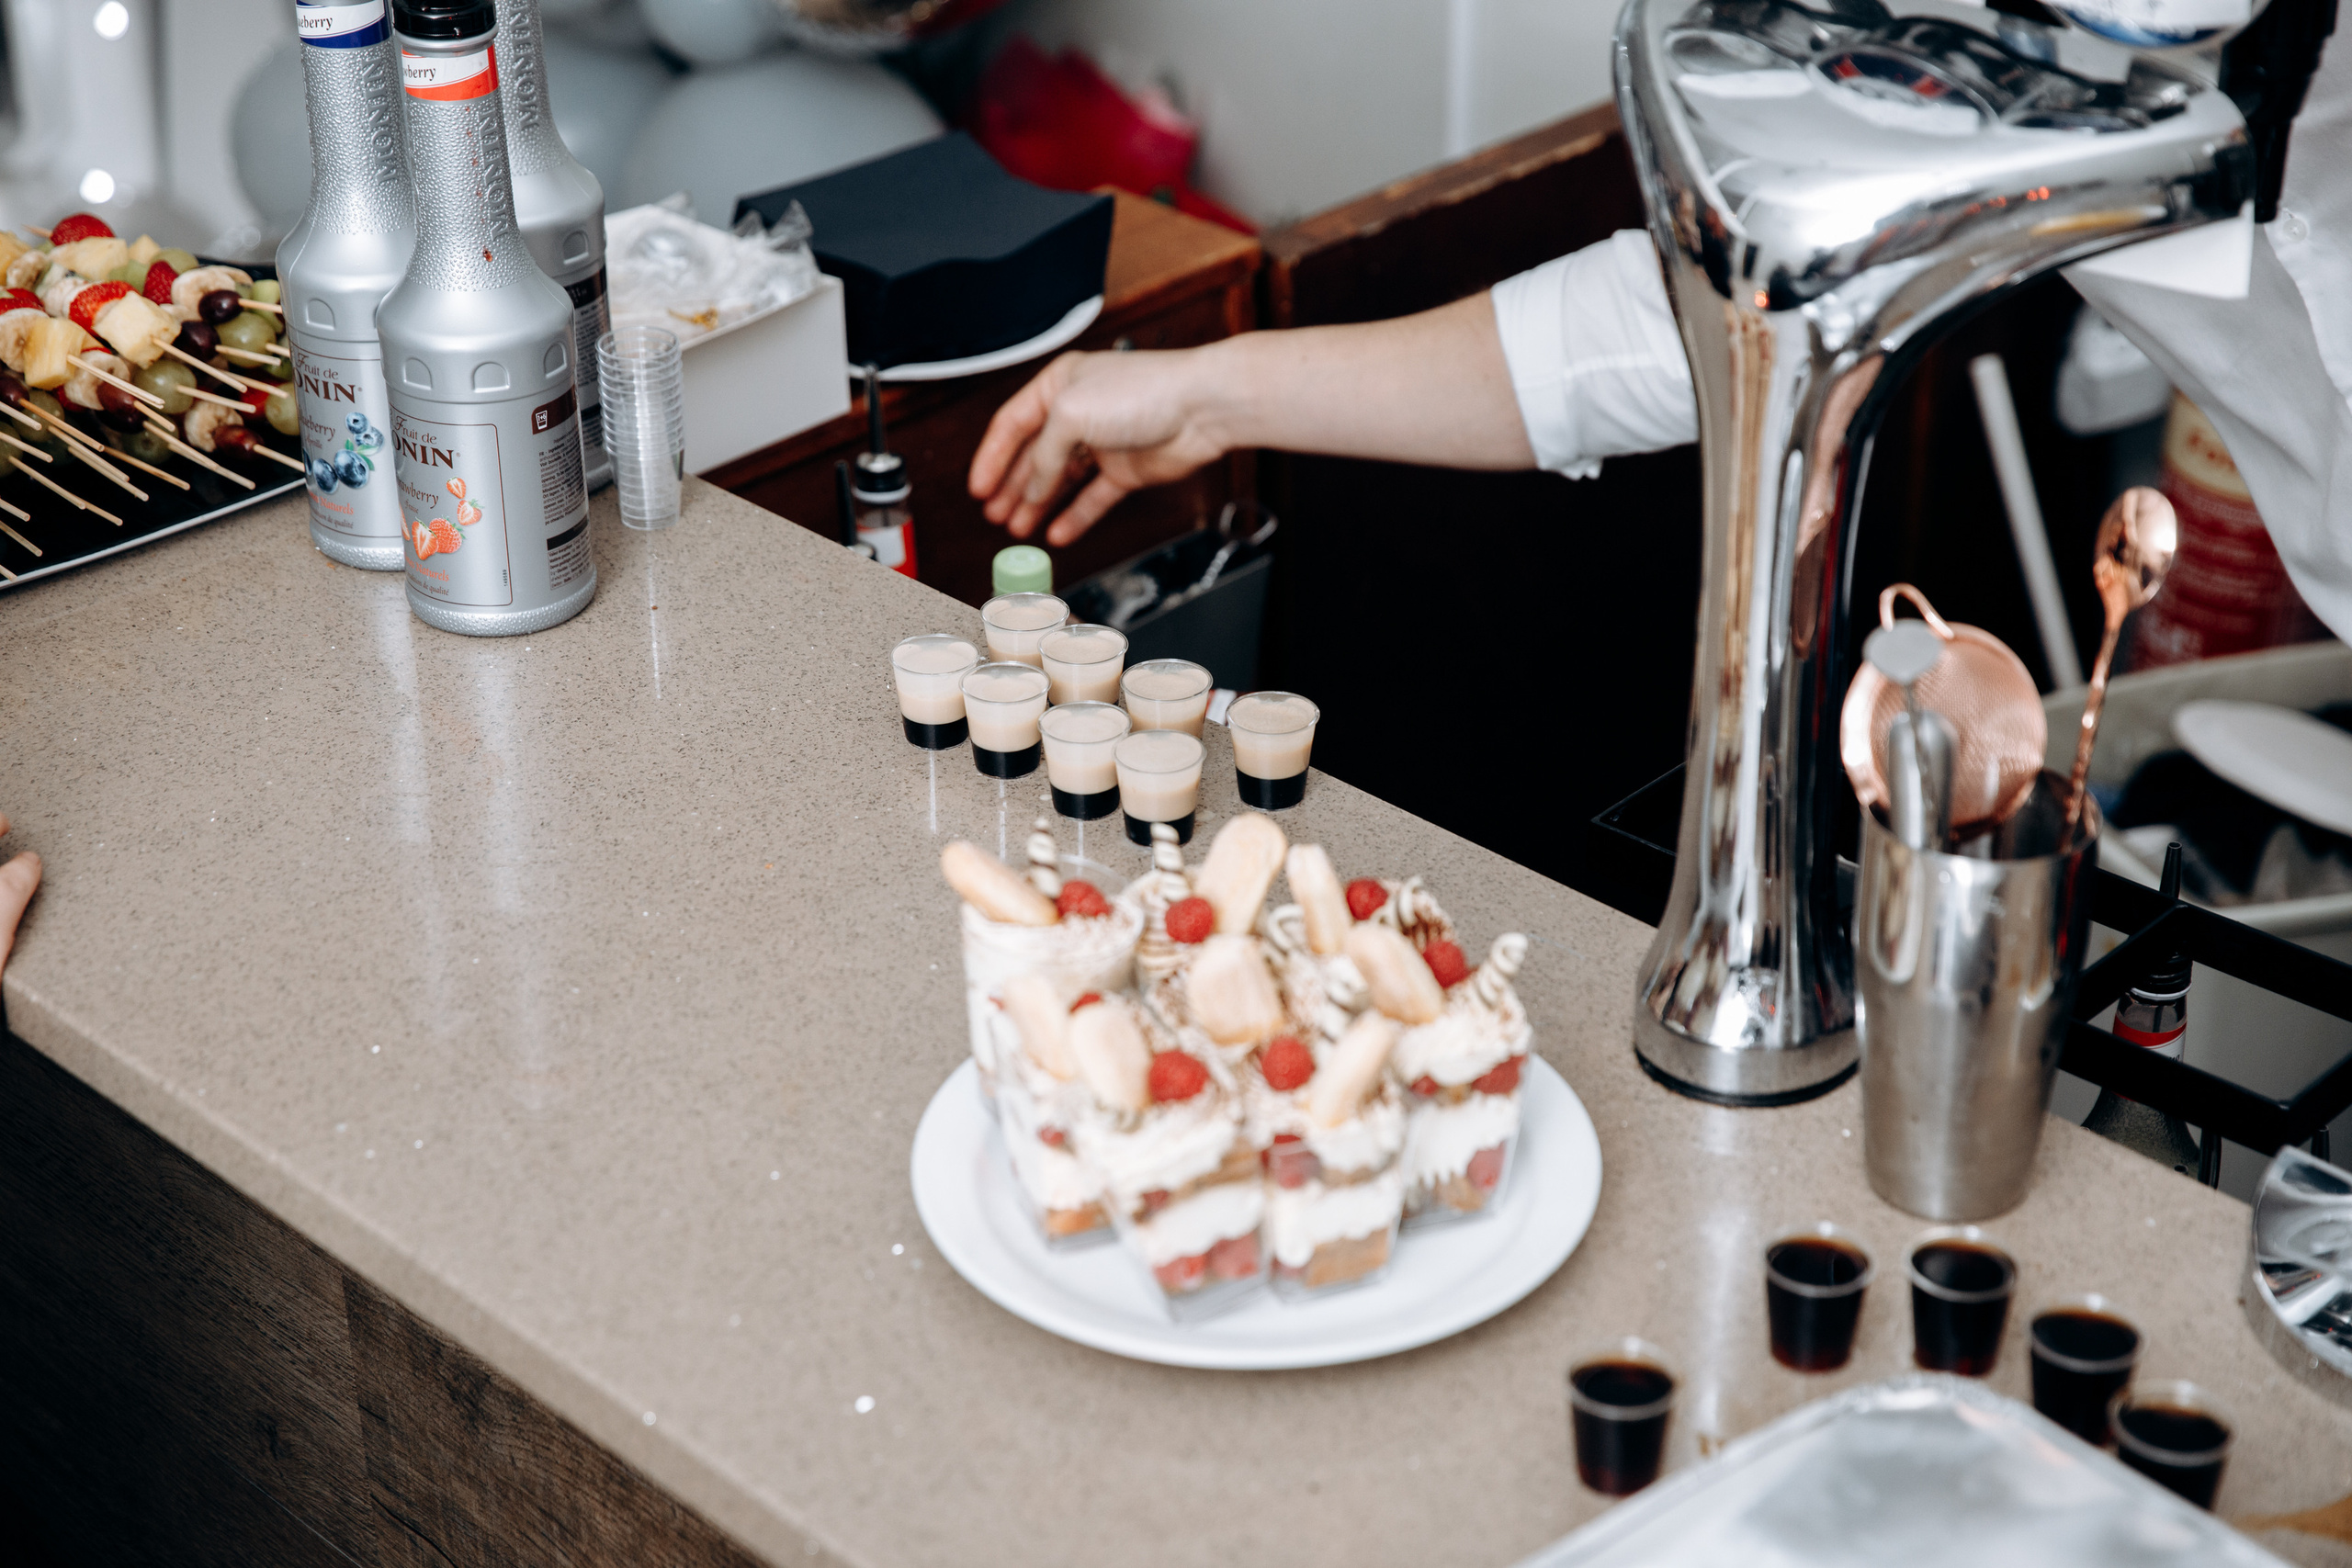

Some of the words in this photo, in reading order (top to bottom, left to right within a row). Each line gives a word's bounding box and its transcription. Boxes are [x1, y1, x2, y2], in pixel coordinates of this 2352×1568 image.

[361, 57, 397, 184] MONIN
[478, 108, 508, 241] MONIN
[296, 352, 320, 377] Fruit
[322, 368, 339, 380] de
[394, 415, 418, 440] Fruit
[421, 433, 437, 445] de
[415, 562, 449, 582] Naturels
